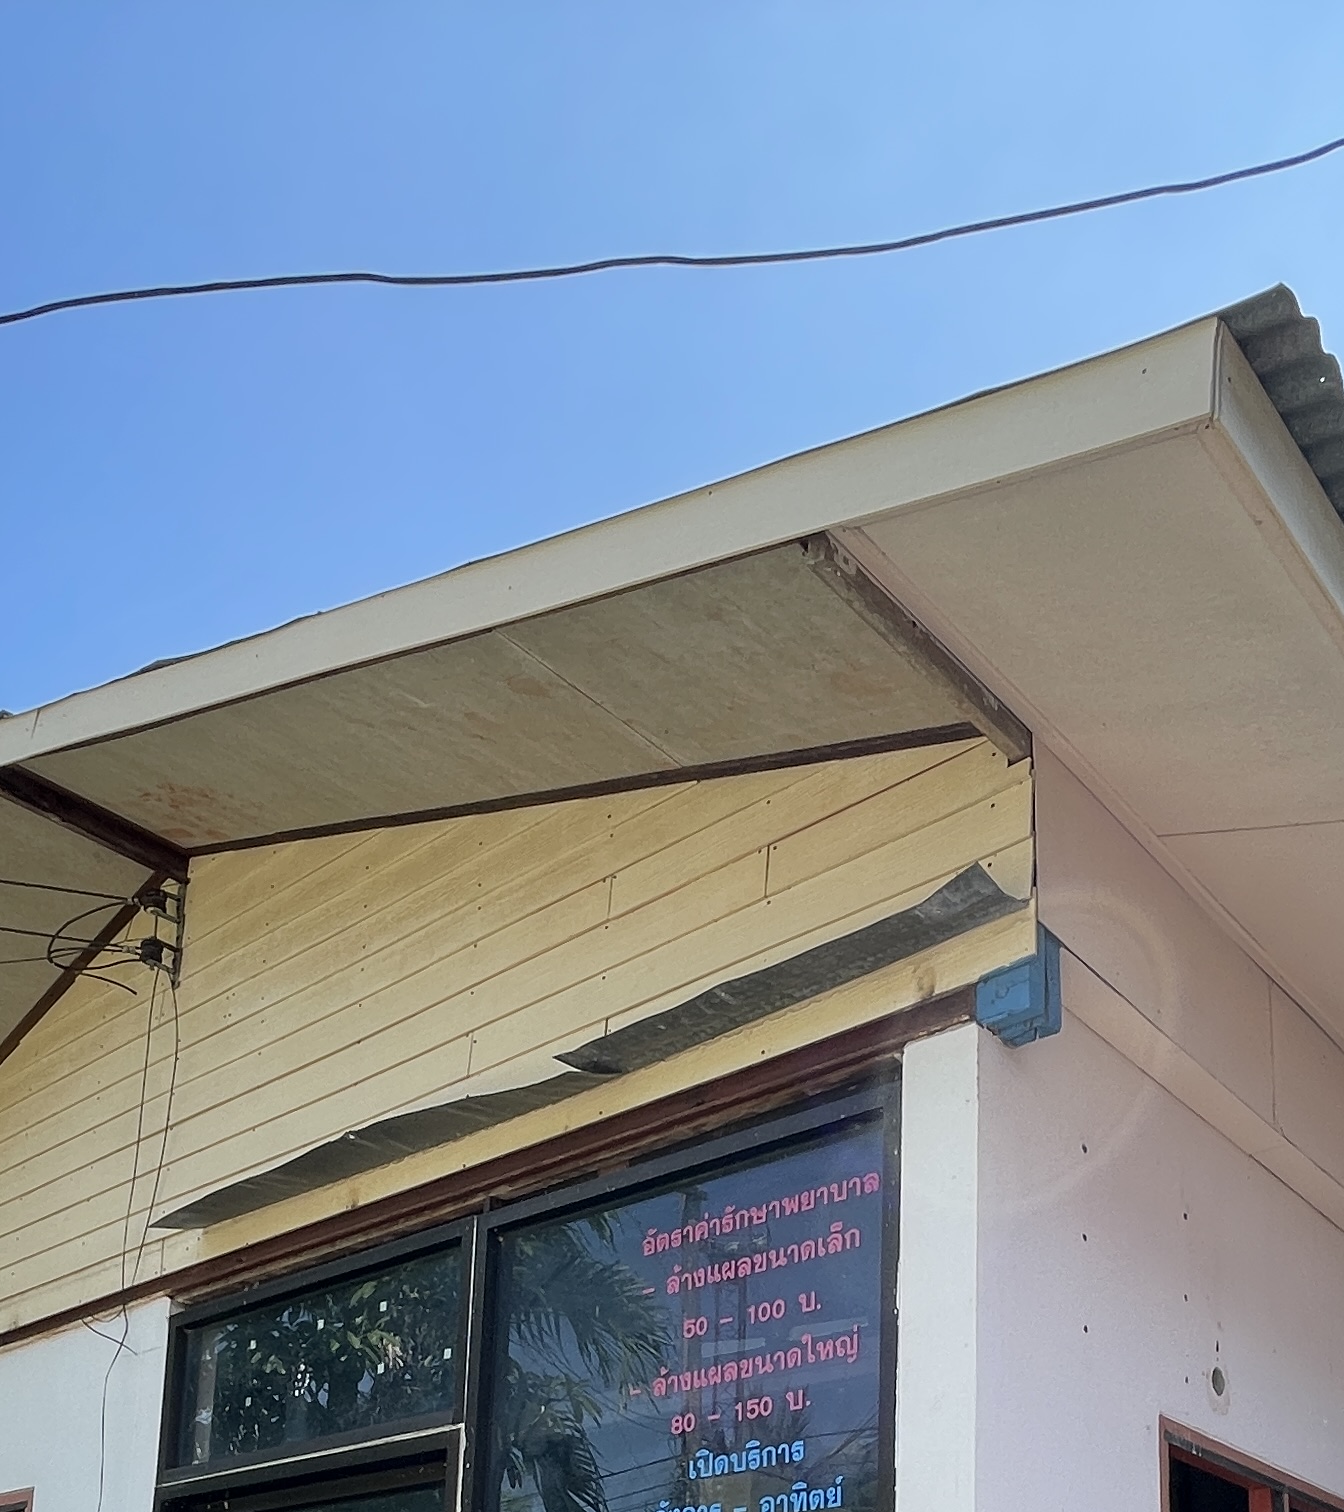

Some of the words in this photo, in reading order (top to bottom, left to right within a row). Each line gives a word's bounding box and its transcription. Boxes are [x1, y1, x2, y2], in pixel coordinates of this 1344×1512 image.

[642, 1172, 880, 1256] อัตราค่ารักษาพยาบาล
[666, 1221, 860, 1294] ล้างแผลขนาดเล็ก
[683, 1317, 707, 1338] 50
[748, 1300, 785, 1324] 100
[799, 1292, 821, 1313] บ.
[652, 1325, 860, 1397] ล้างแผลขนาดใหญ่
[671, 1413, 694, 1434] 80
[735, 1396, 772, 1422] 150
[786, 1389, 811, 1411] บ.
[689, 1440, 805, 1479] เปิดบริการ
